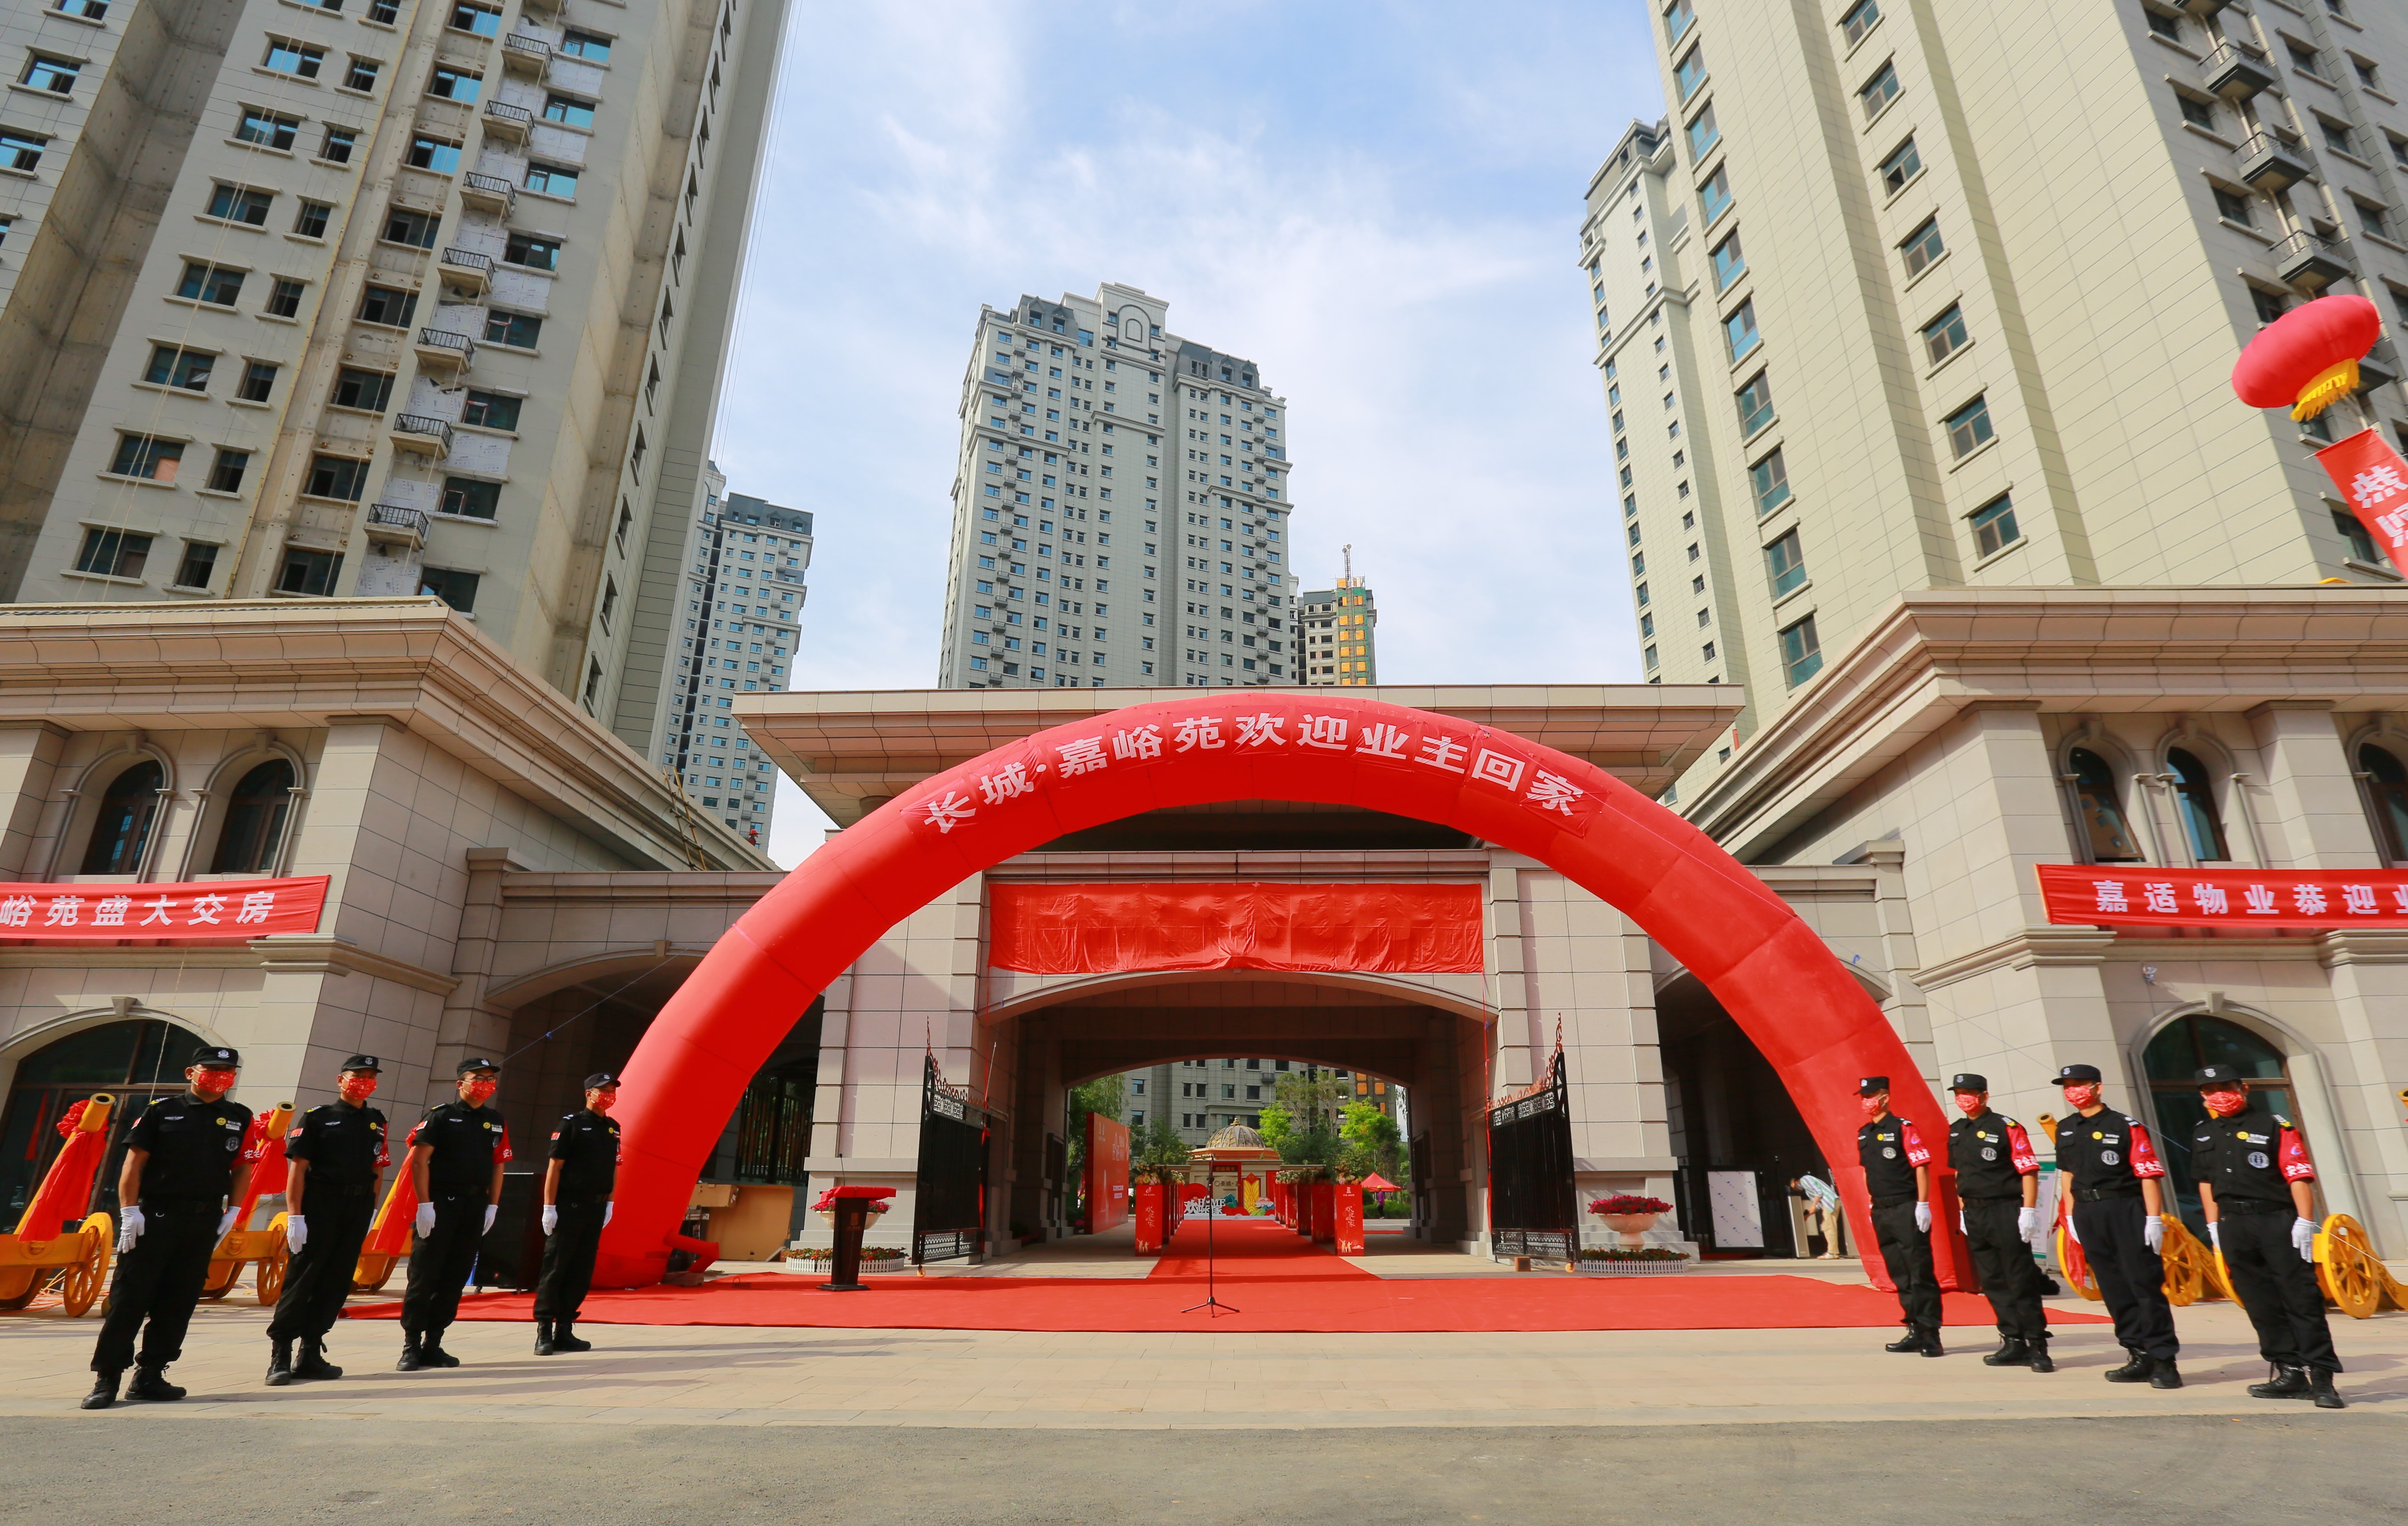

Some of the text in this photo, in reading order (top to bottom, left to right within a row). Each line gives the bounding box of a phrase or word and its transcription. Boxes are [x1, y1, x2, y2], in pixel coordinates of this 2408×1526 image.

[924, 712, 1584, 833] 长城·嘉峪苑欢迎业主回家
[0, 891, 275, 927] 峪苑盛大交房
